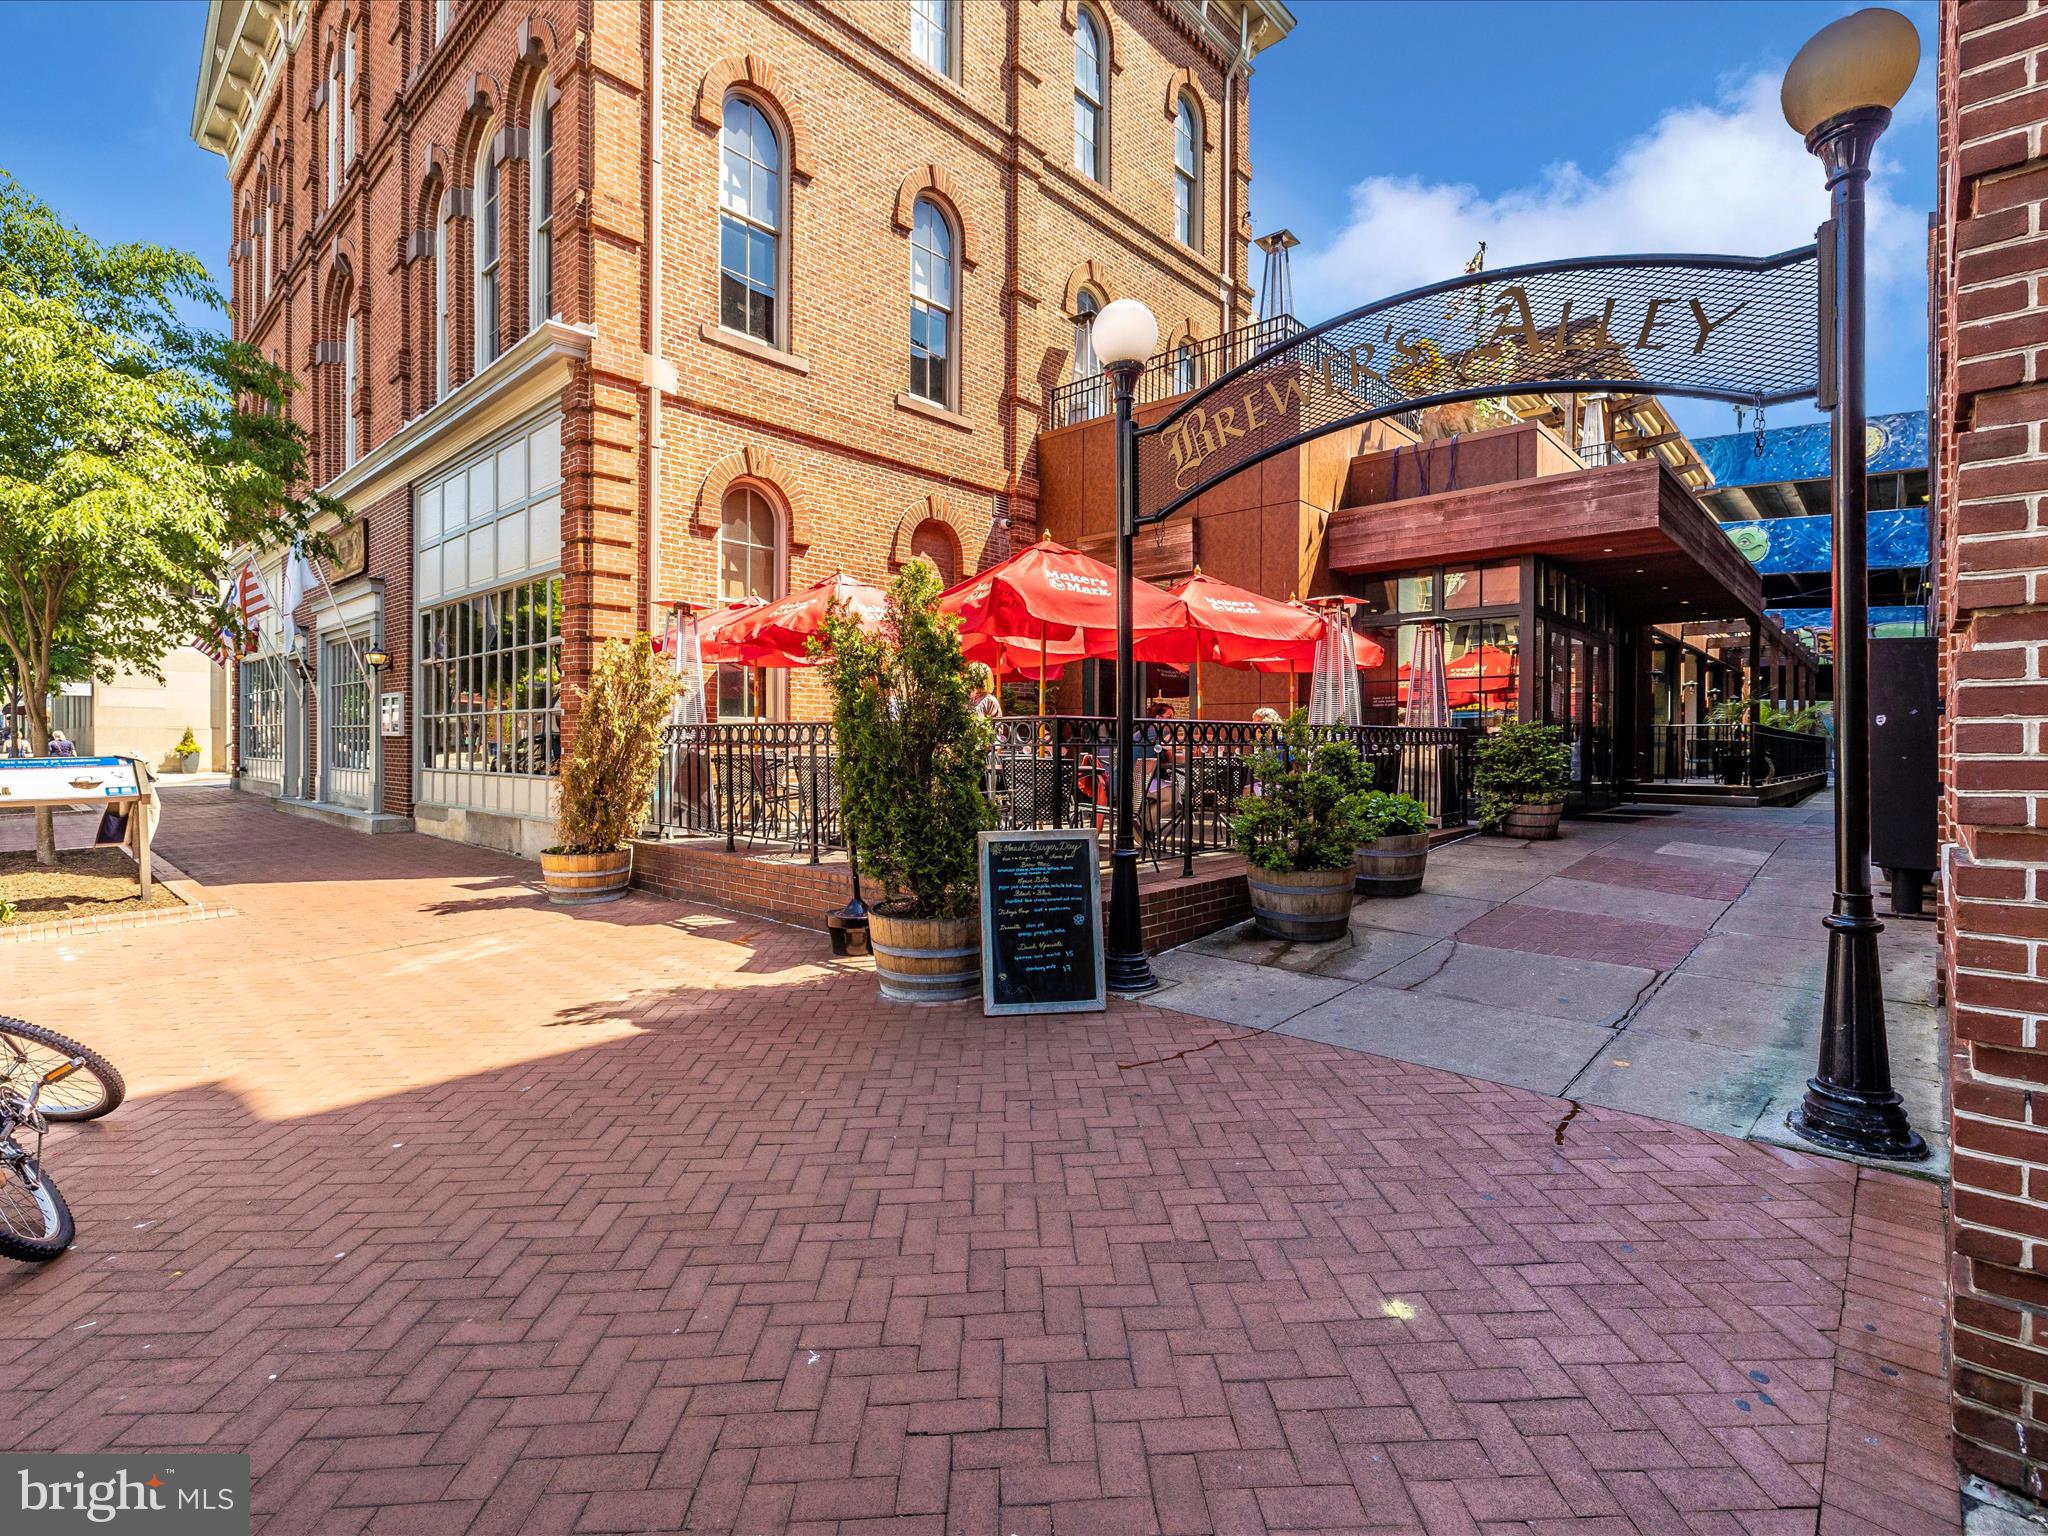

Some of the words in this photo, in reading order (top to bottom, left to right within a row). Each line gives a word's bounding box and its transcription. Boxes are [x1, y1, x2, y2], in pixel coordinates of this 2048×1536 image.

[1065, 581, 1113, 597] Mark
[1028, 841, 1058, 855] Burger
[1059, 841, 1082, 857] Day
